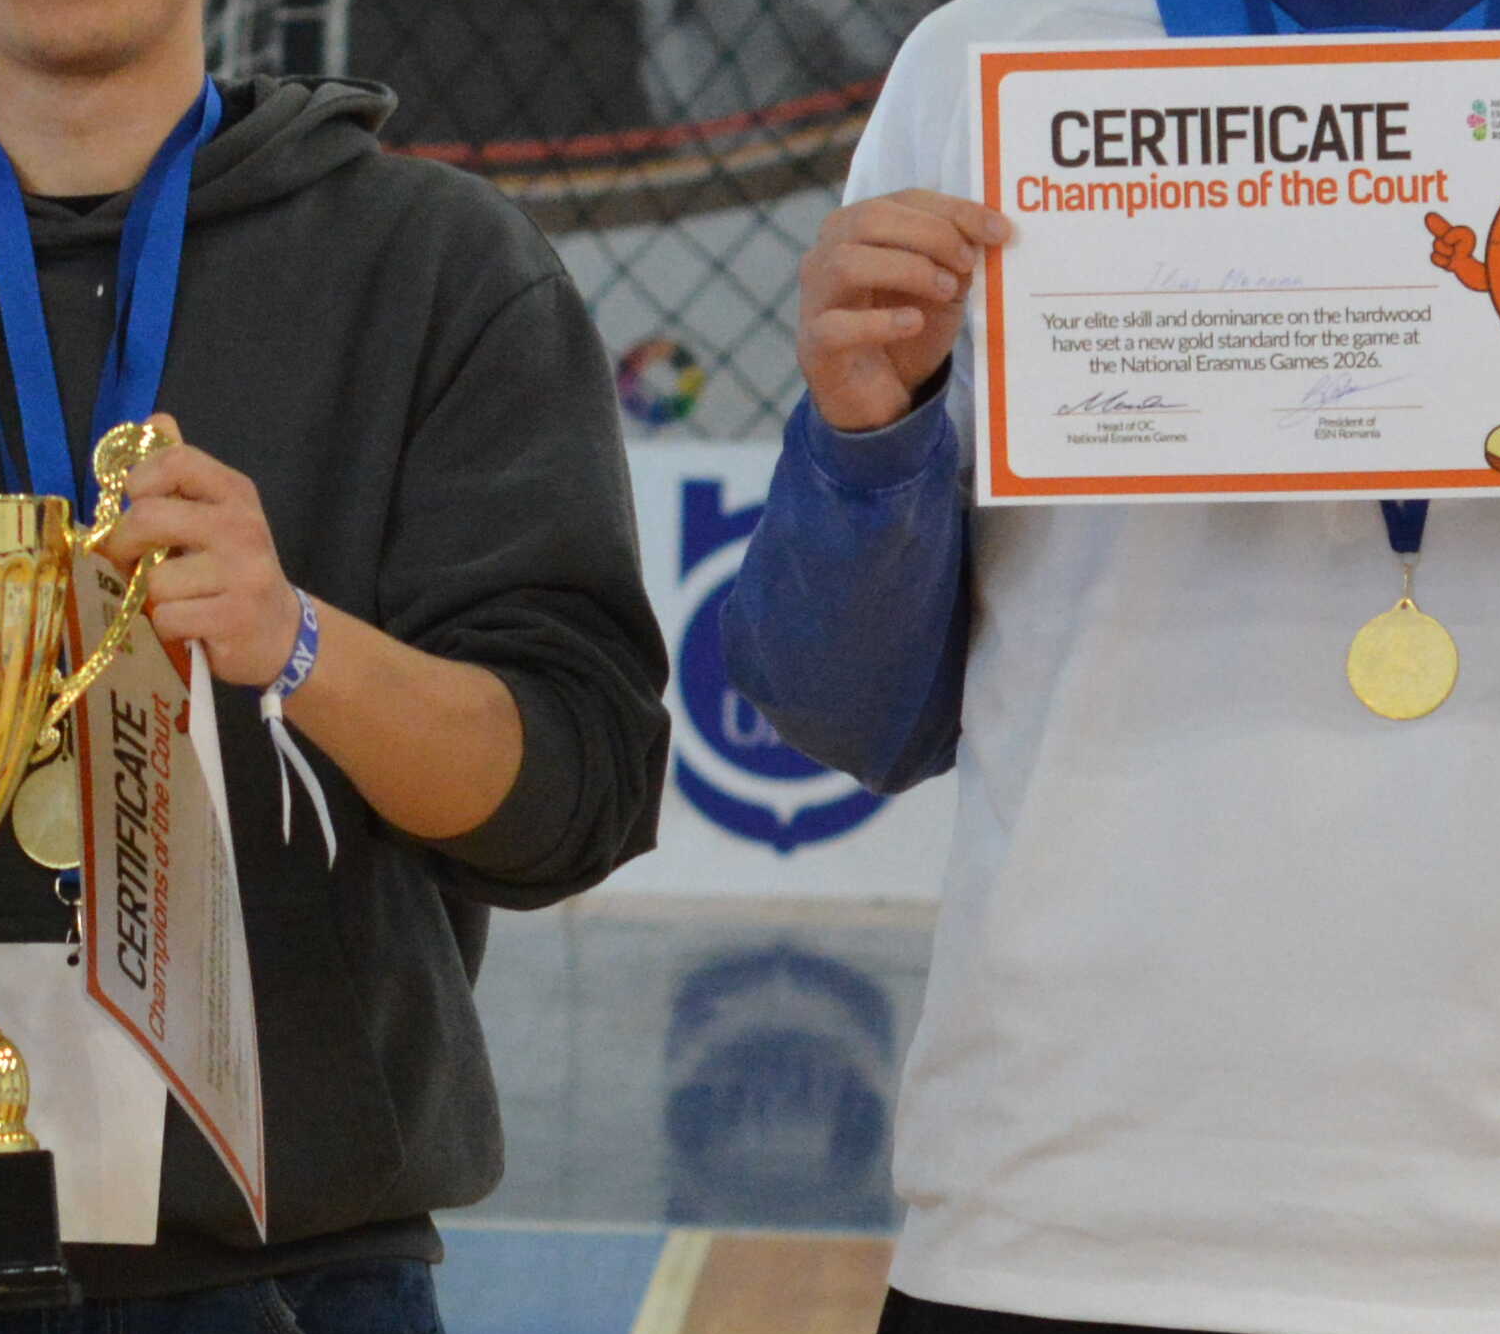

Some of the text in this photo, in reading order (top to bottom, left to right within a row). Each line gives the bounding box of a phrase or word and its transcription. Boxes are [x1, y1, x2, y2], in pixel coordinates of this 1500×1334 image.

[1051, 102, 1411, 168] CERTIFICATE
[1017, 169, 1448, 218] Champions of the Court
[1043, 305, 1431, 330] Your elite skill and dominance on the hardwood
[1052, 329, 1419, 354] have set a new gold standard for the game at
[1090, 351, 1382, 374] the National Erasmus Games 2026.
[111, 689, 148, 990] CERTIFICATE
[148, 693, 170, 1042] Champions of the Court
